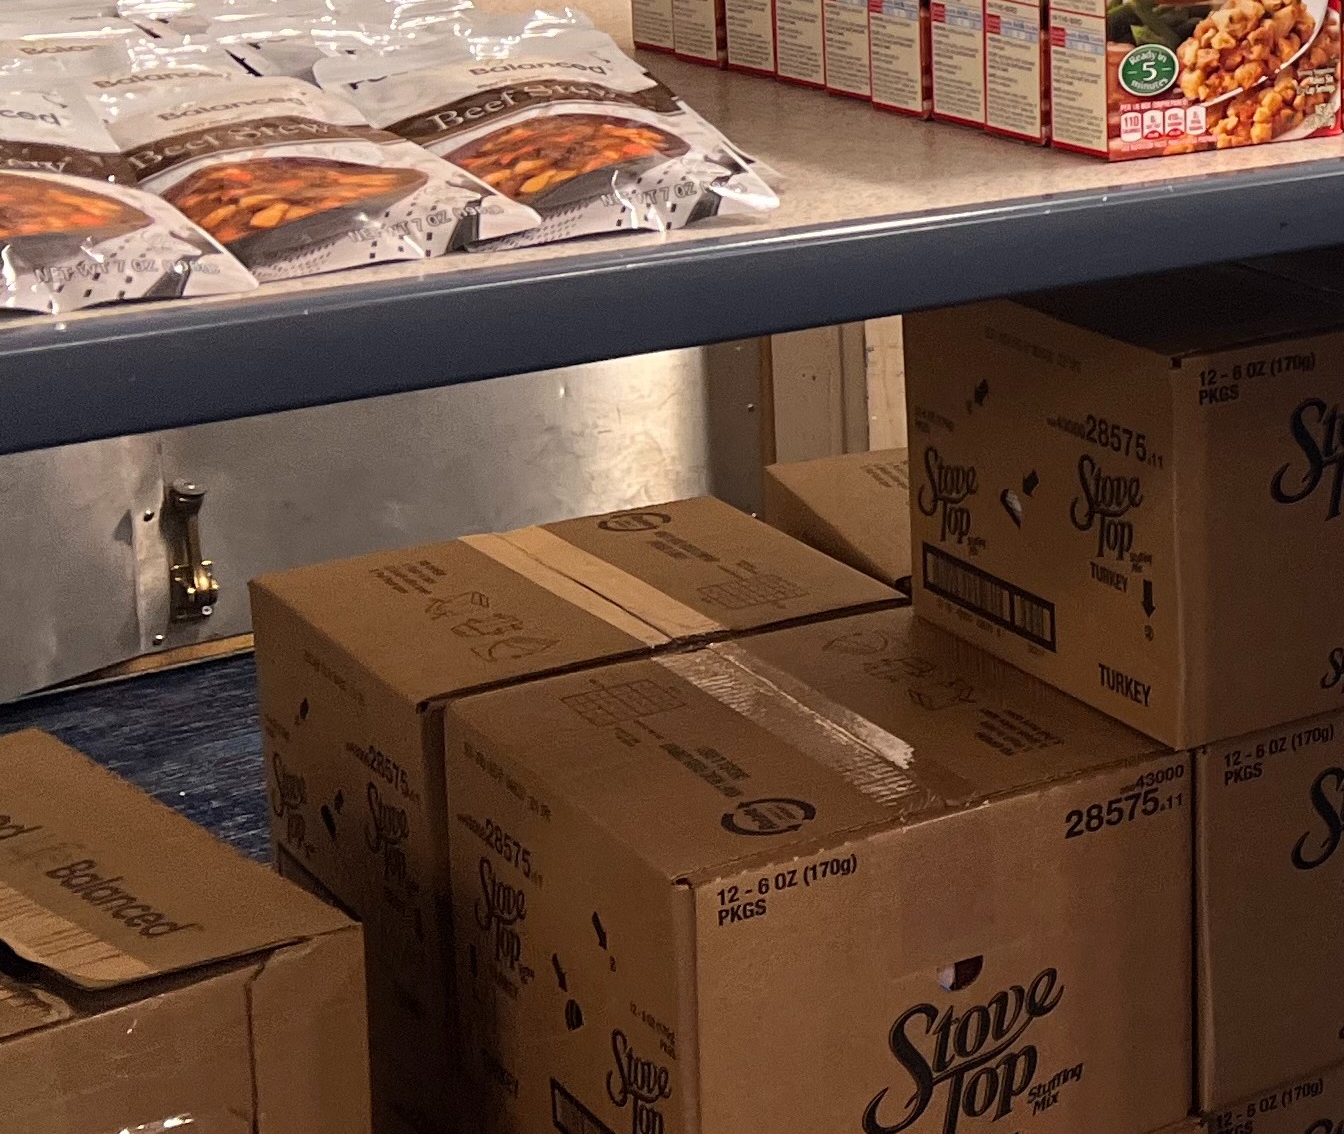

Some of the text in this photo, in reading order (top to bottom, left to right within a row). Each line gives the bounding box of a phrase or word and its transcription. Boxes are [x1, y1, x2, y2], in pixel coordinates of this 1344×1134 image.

[1129, 48, 1156, 66] Ready
[1142, 61, 1158, 82] 5
[425, 92, 516, 132] Beef
[129, 132, 224, 170] Beef
[1199, 384, 1240, 405] PKGS
[918, 446, 978, 516] Stove
[1070, 454, 1143, 531] Stove
[1095, 512, 1134, 561] Top
[1090, 561, 1128, 593] TURKEY
[1098, 663, 1151, 707] TURKEY
[1224, 762, 1264, 786] PKGS
[46, 859, 200, 939] Balanced
[717, 854, 858, 907] 12 6 OZ (170g)
[717, 898, 768, 926] PKGS
[606, 1028, 672, 1107] Stove
[862, 967, 1064, 1134] Stove
